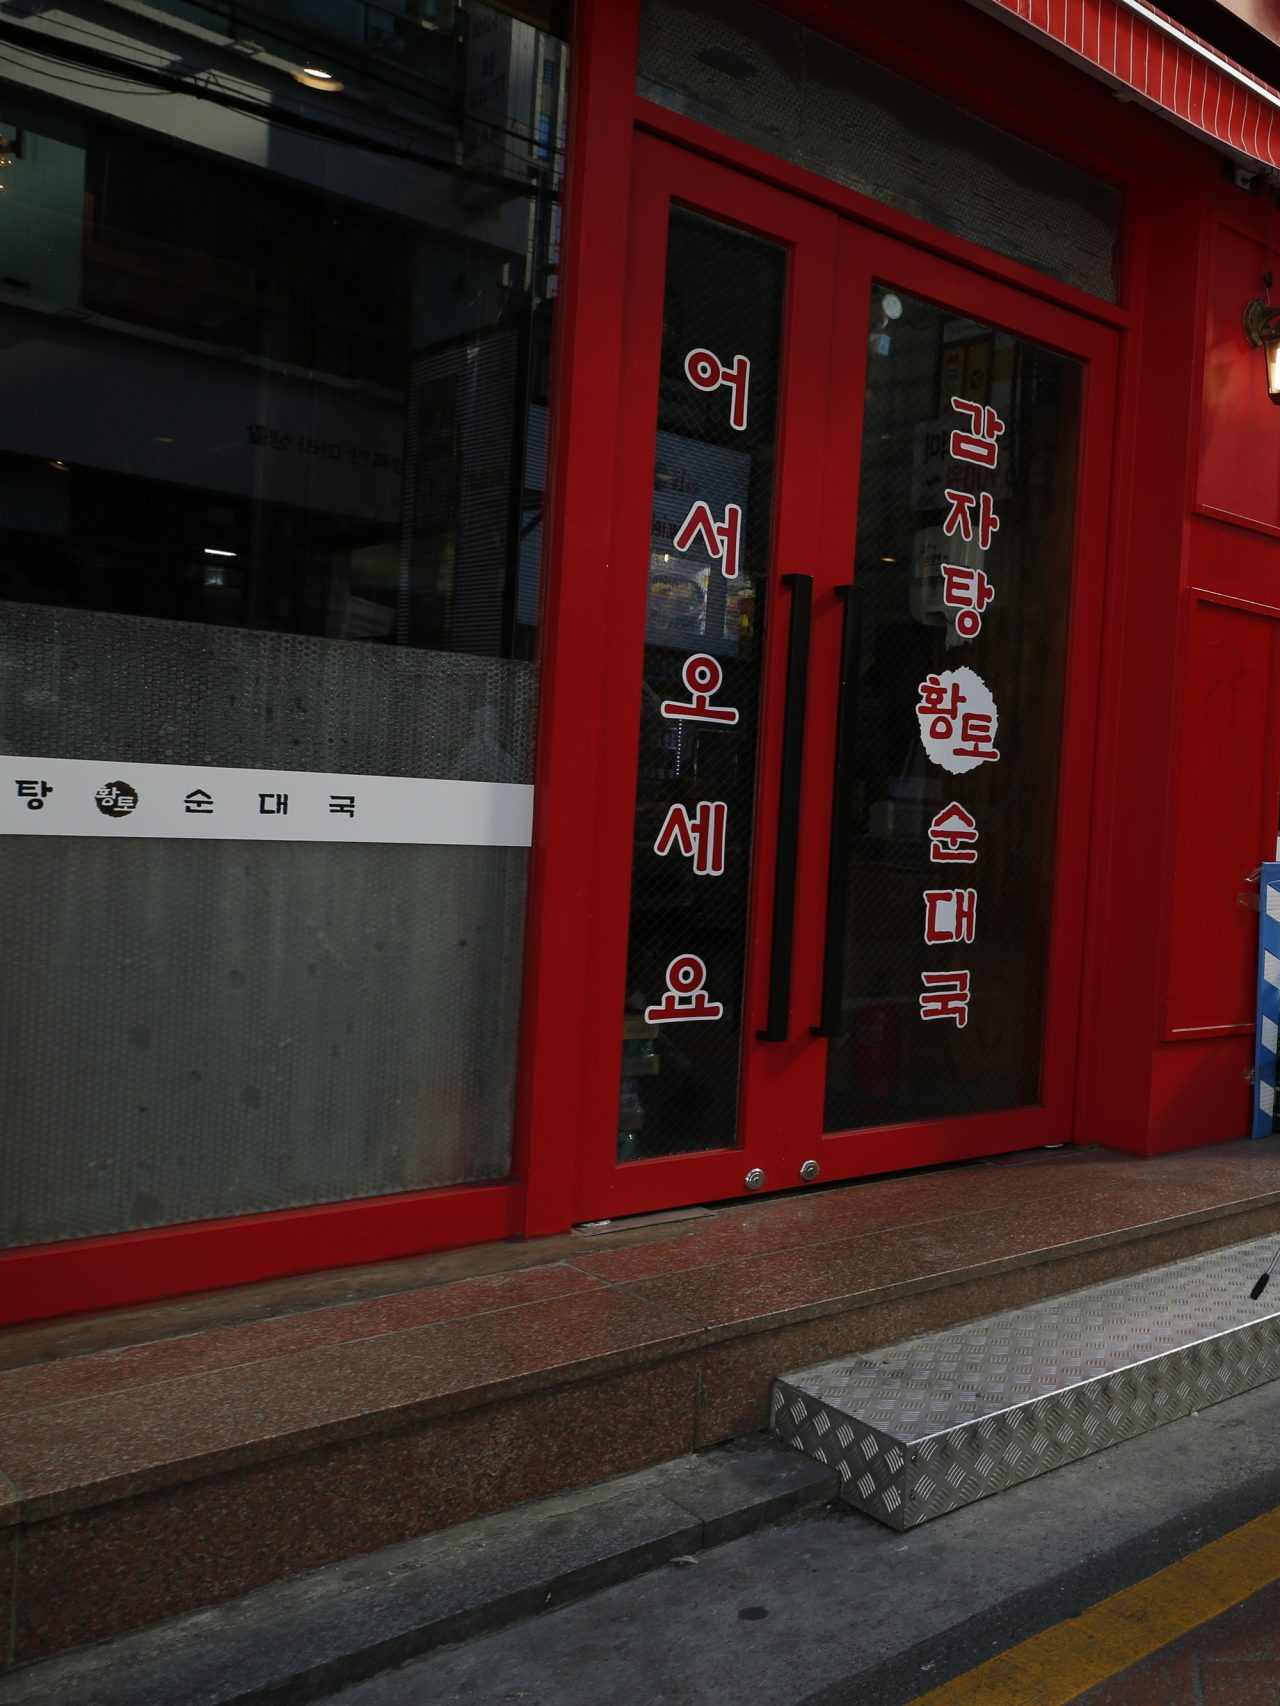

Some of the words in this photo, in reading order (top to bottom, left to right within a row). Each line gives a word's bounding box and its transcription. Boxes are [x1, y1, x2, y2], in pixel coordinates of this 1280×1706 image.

[941, 396, 1005, 638] 감자탕
[916, 675, 1000, 761] 황토
[15, 780, 53, 810] 탕
[96, 787, 136, 812] 황토
[184, 788, 356, 818] 순대국
[919, 801, 978, 1029] 순대국
